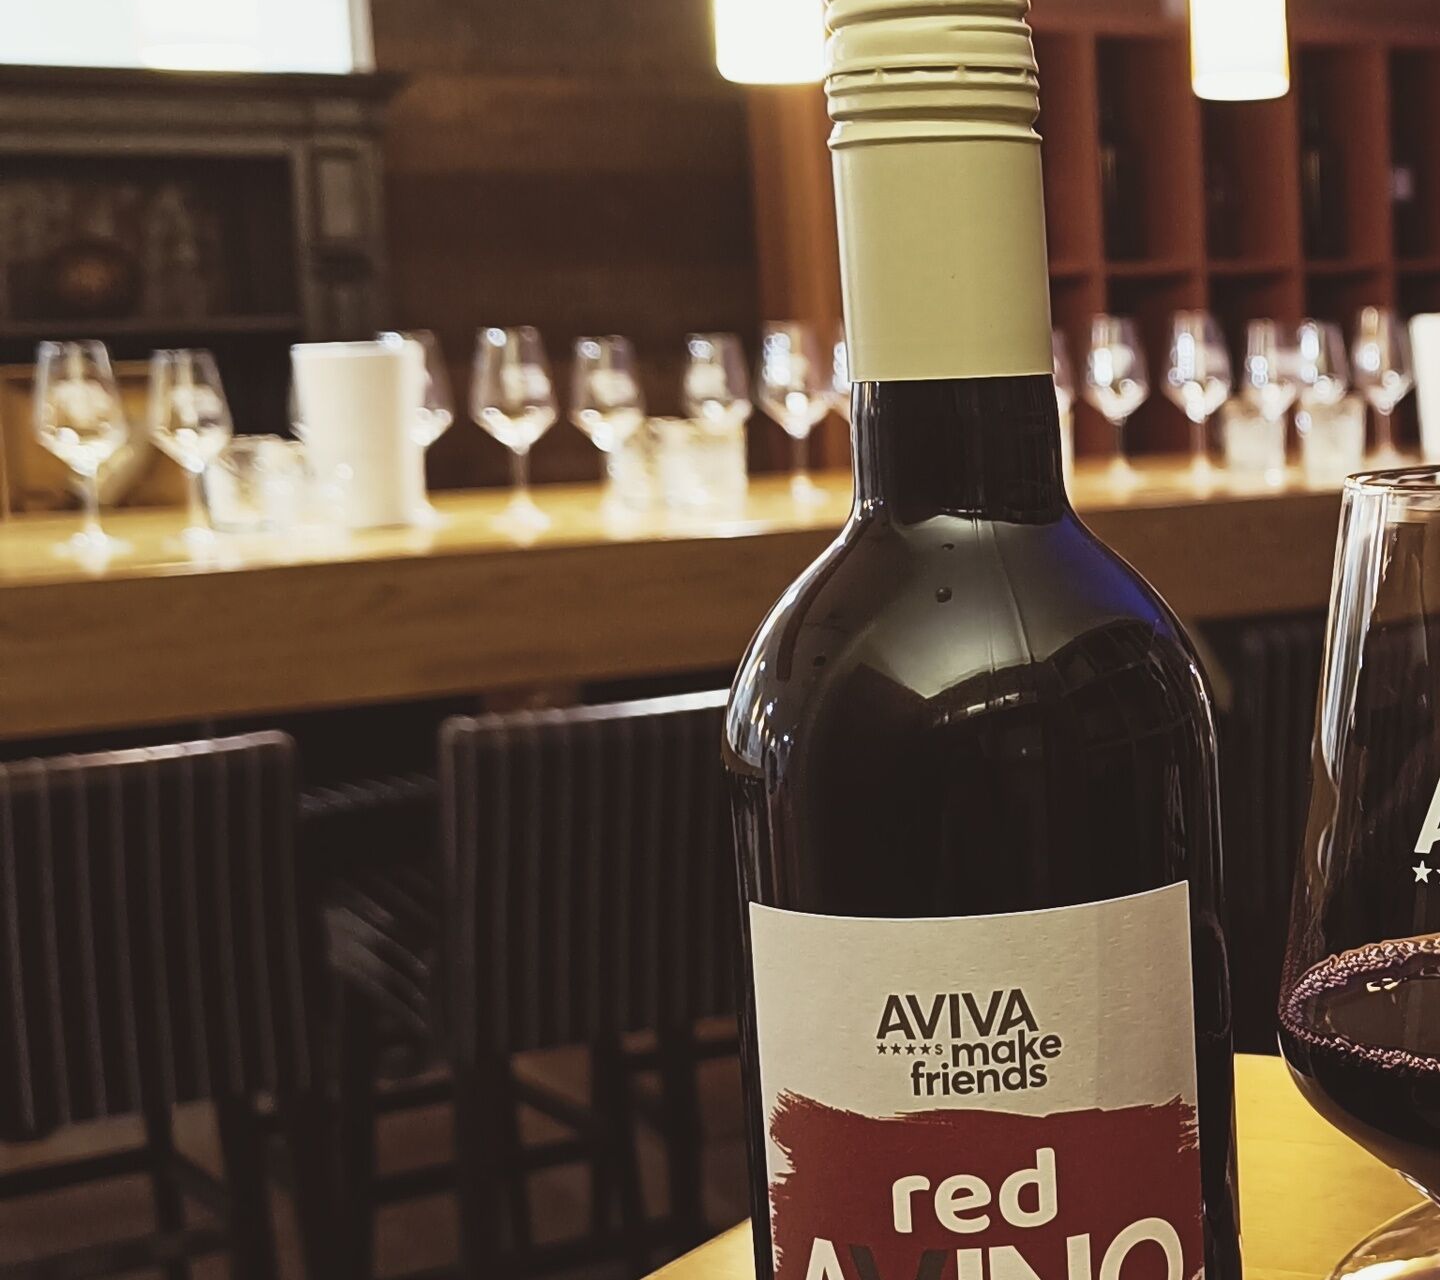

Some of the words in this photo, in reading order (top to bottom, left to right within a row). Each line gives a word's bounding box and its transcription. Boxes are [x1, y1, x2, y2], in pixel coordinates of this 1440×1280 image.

[876, 988, 1040, 1040] AVIVA
[951, 1029, 1062, 1067] make
[910, 1060, 1049, 1096] friends
[892, 1147, 1058, 1234] red
